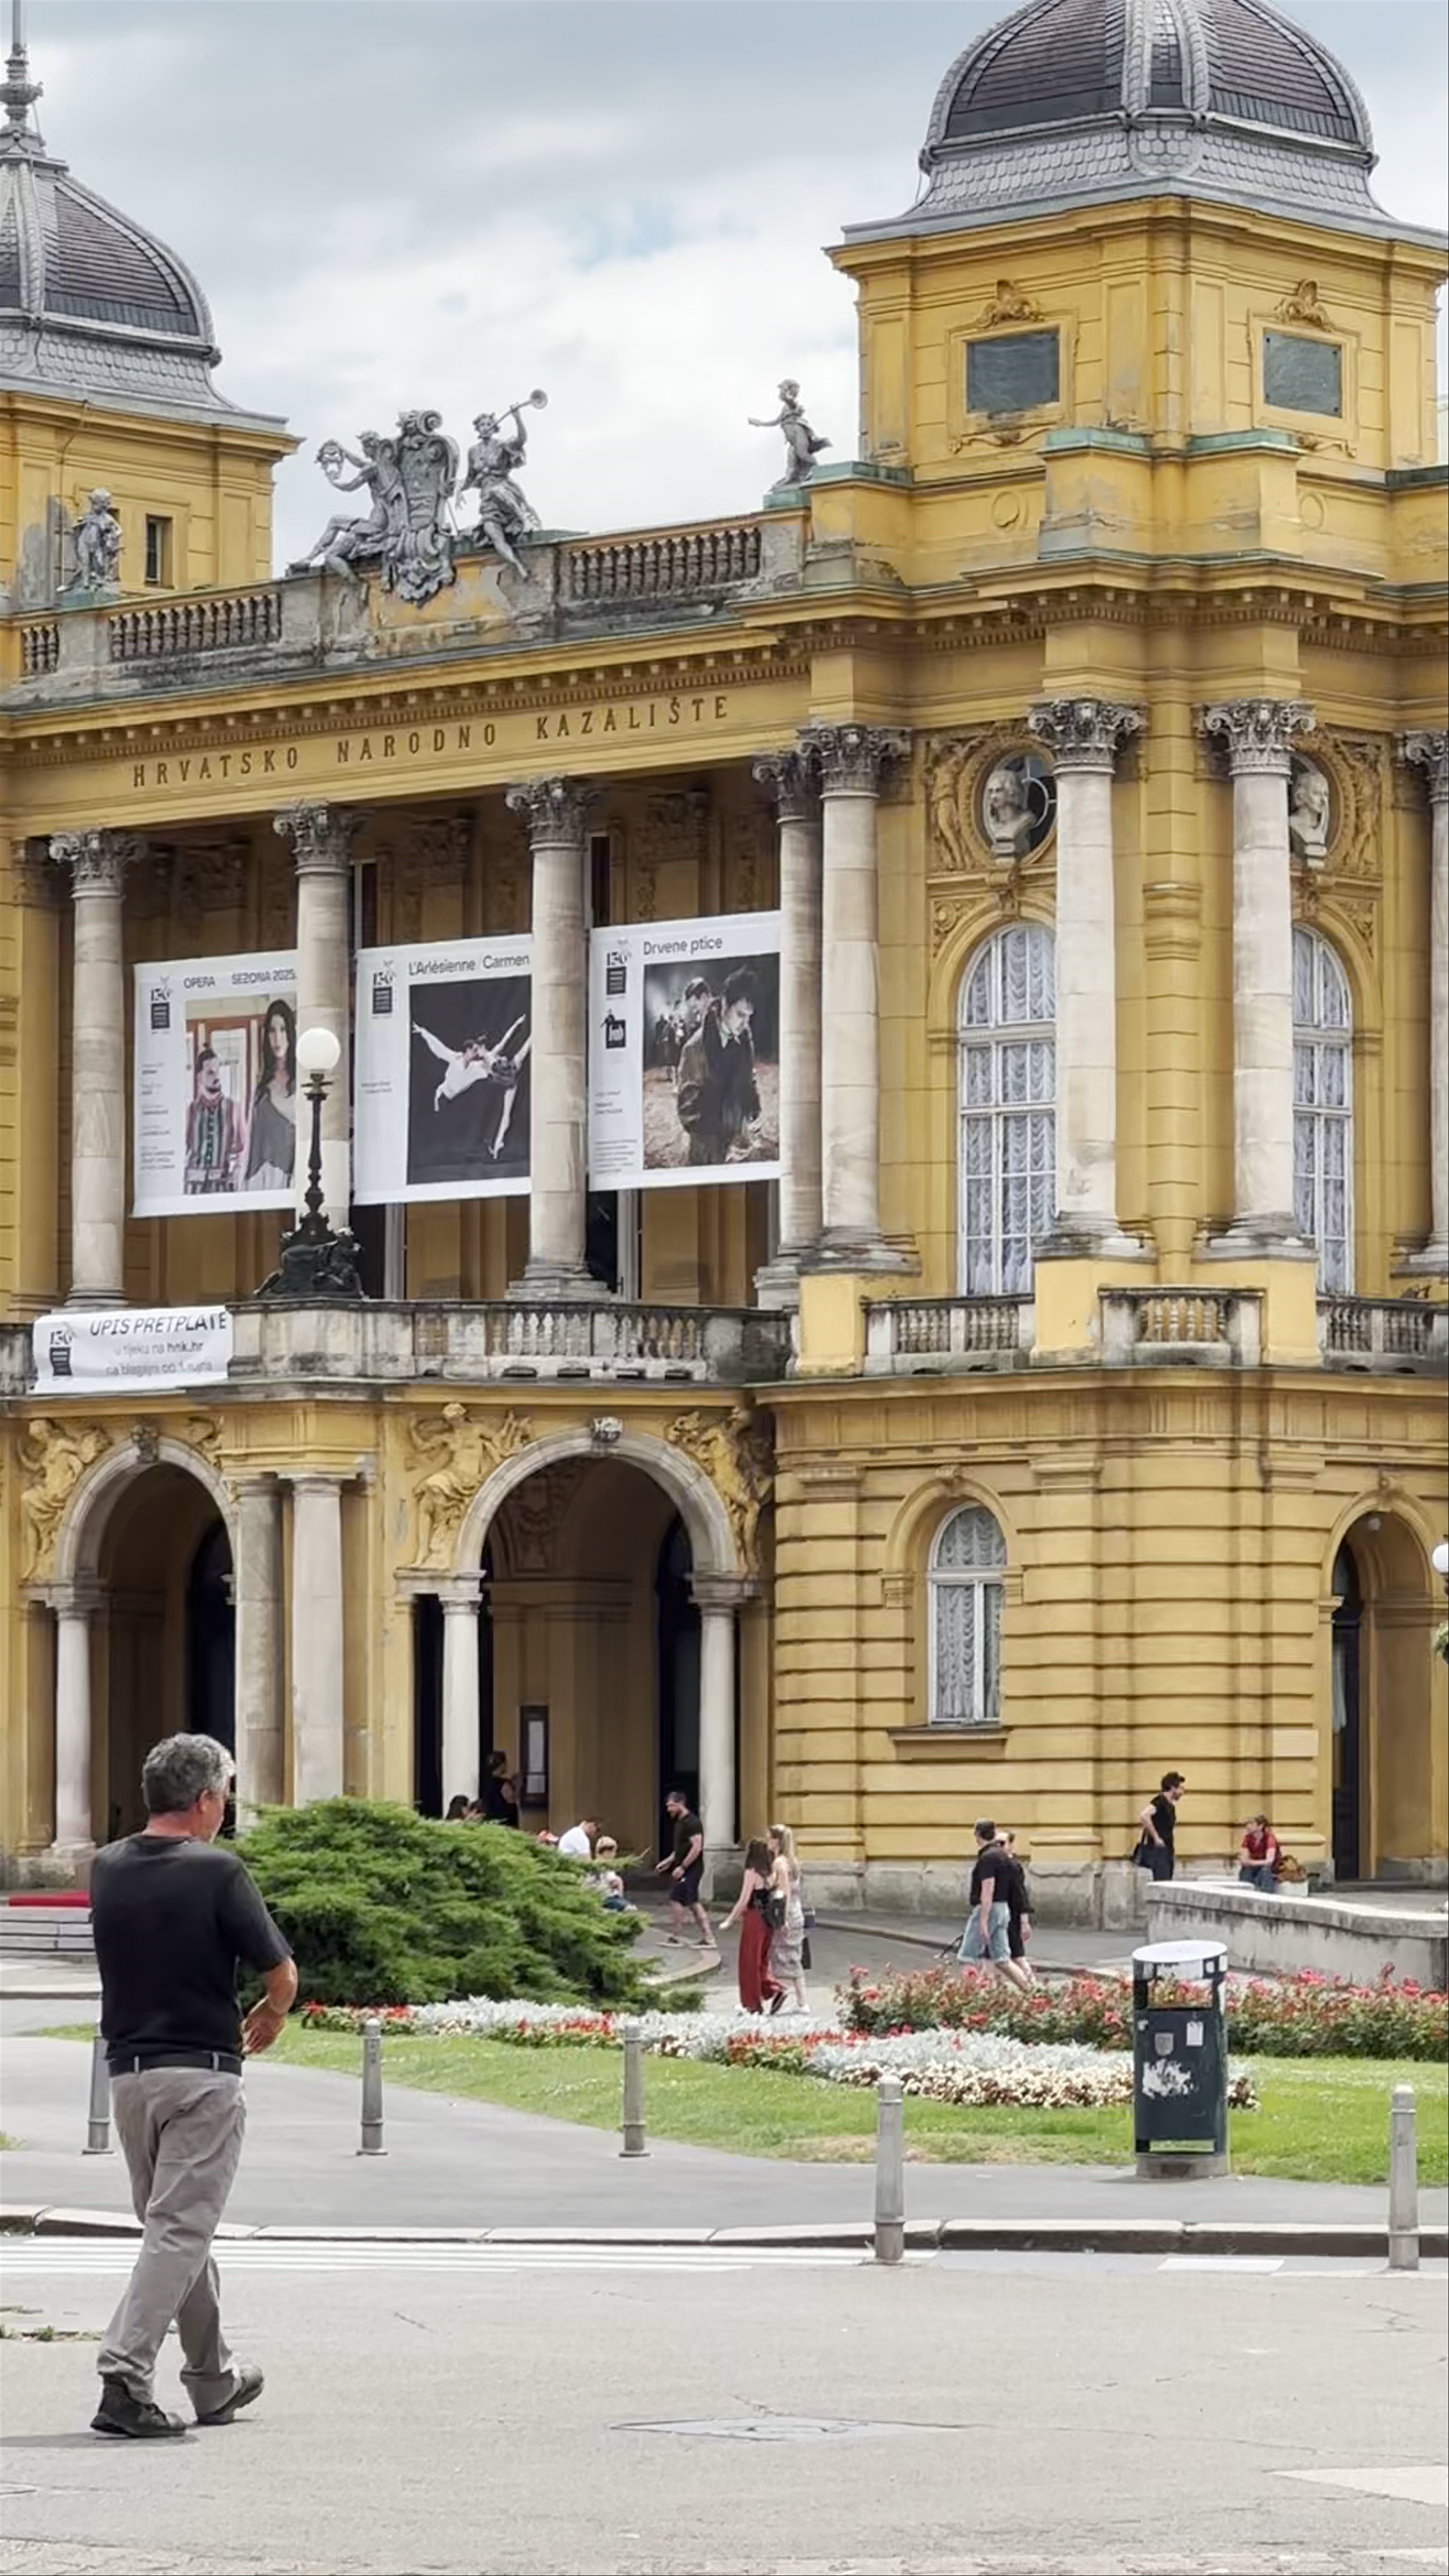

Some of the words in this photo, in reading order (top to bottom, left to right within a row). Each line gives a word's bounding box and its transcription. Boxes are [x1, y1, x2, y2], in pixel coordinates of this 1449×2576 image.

[134, 746, 298, 787] HRVATSKO
[337, 723, 495, 763] NARODNO
[536, 696, 727, 740] KAZALIŠTE
[643, 941, 687, 955] Drvene
[690, 936, 723, 954] ptice
[483, 954, 529, 969] Carmen
[184, 977, 215, 989] OPERA
[90, 1318, 131, 1336] UPIS
[133, 1312, 226, 1334] PRETPLATE
